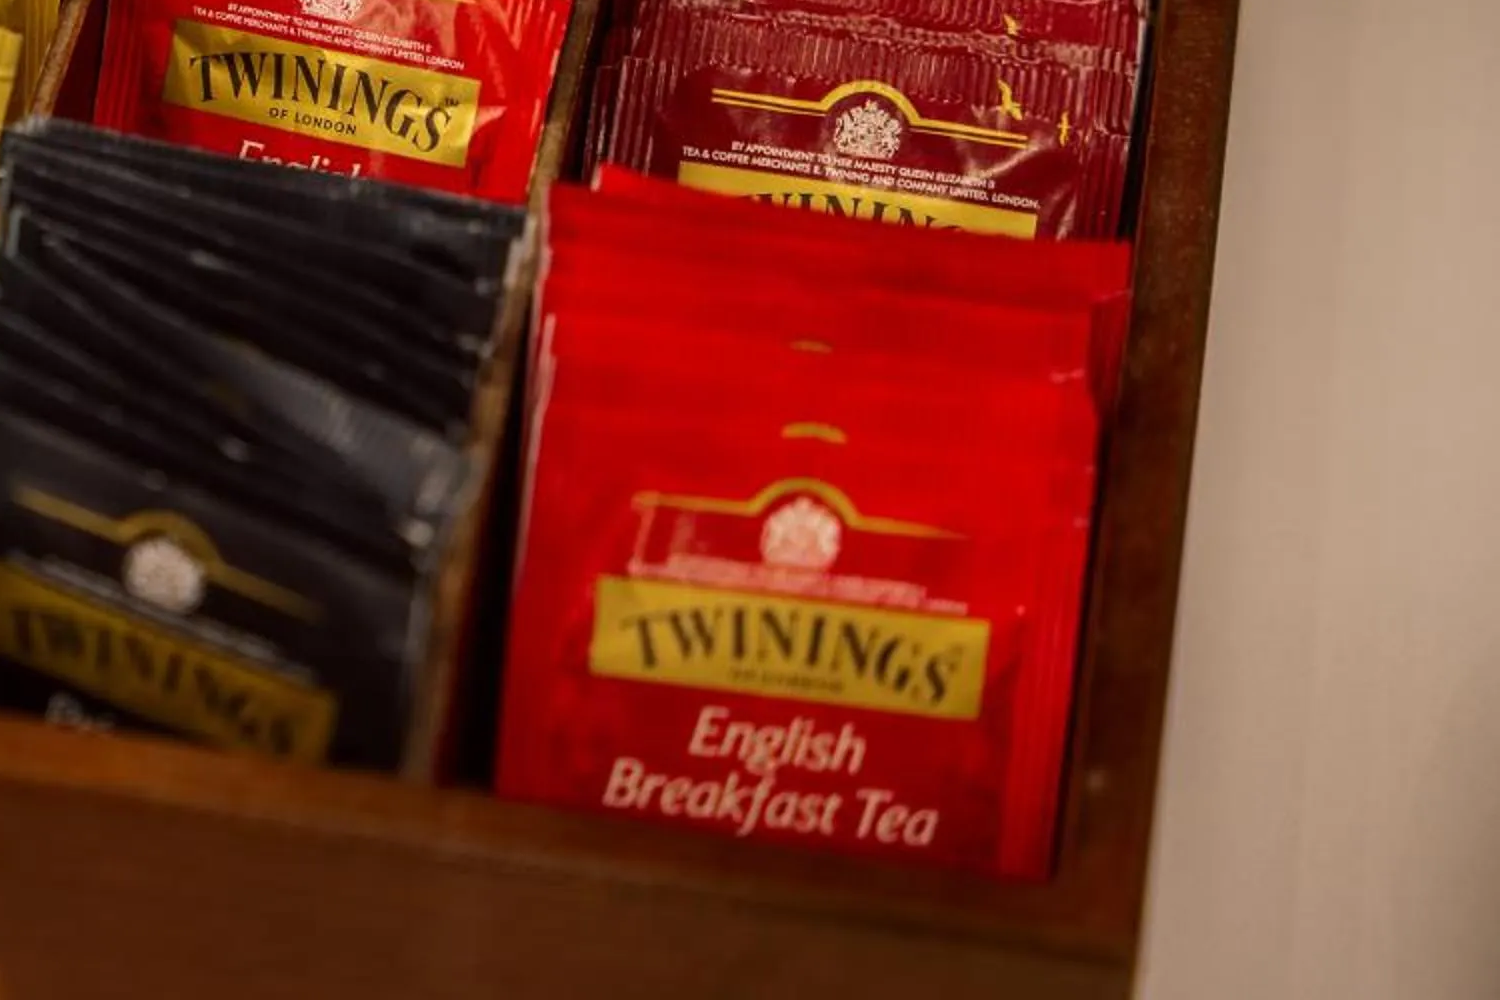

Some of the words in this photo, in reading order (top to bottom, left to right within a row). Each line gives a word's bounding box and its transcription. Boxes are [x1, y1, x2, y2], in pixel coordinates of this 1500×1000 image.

[190, 50, 453, 153] TWININGS
[269, 107, 288, 119] OF
[294, 111, 357, 135] LONDON
[682, 144, 702, 157] TEA
[701, 147, 710, 158] &
[711, 149, 749, 164] COFFEE
[750, 155, 810, 174] MERCHANTS
[823, 166, 869, 183] TWINING
[871, 174, 895, 187] AND
[896, 178, 947, 195] COMPANY
[731, 140, 744, 151] BY
[744, 142, 813, 162] APPOINTMENT
[816, 153, 831, 164] TO
[833, 156, 852, 168] HER
[853, 159, 896, 175] MAJESTY
[898, 166, 934, 181] QUEEN
[935, 172, 986, 189] ELIZABETH
[619, 606, 958, 705] TWININGS
[688, 704, 867, 777] English
[601, 756, 842, 837] Breakfast
[855, 786, 940, 847] Tea
